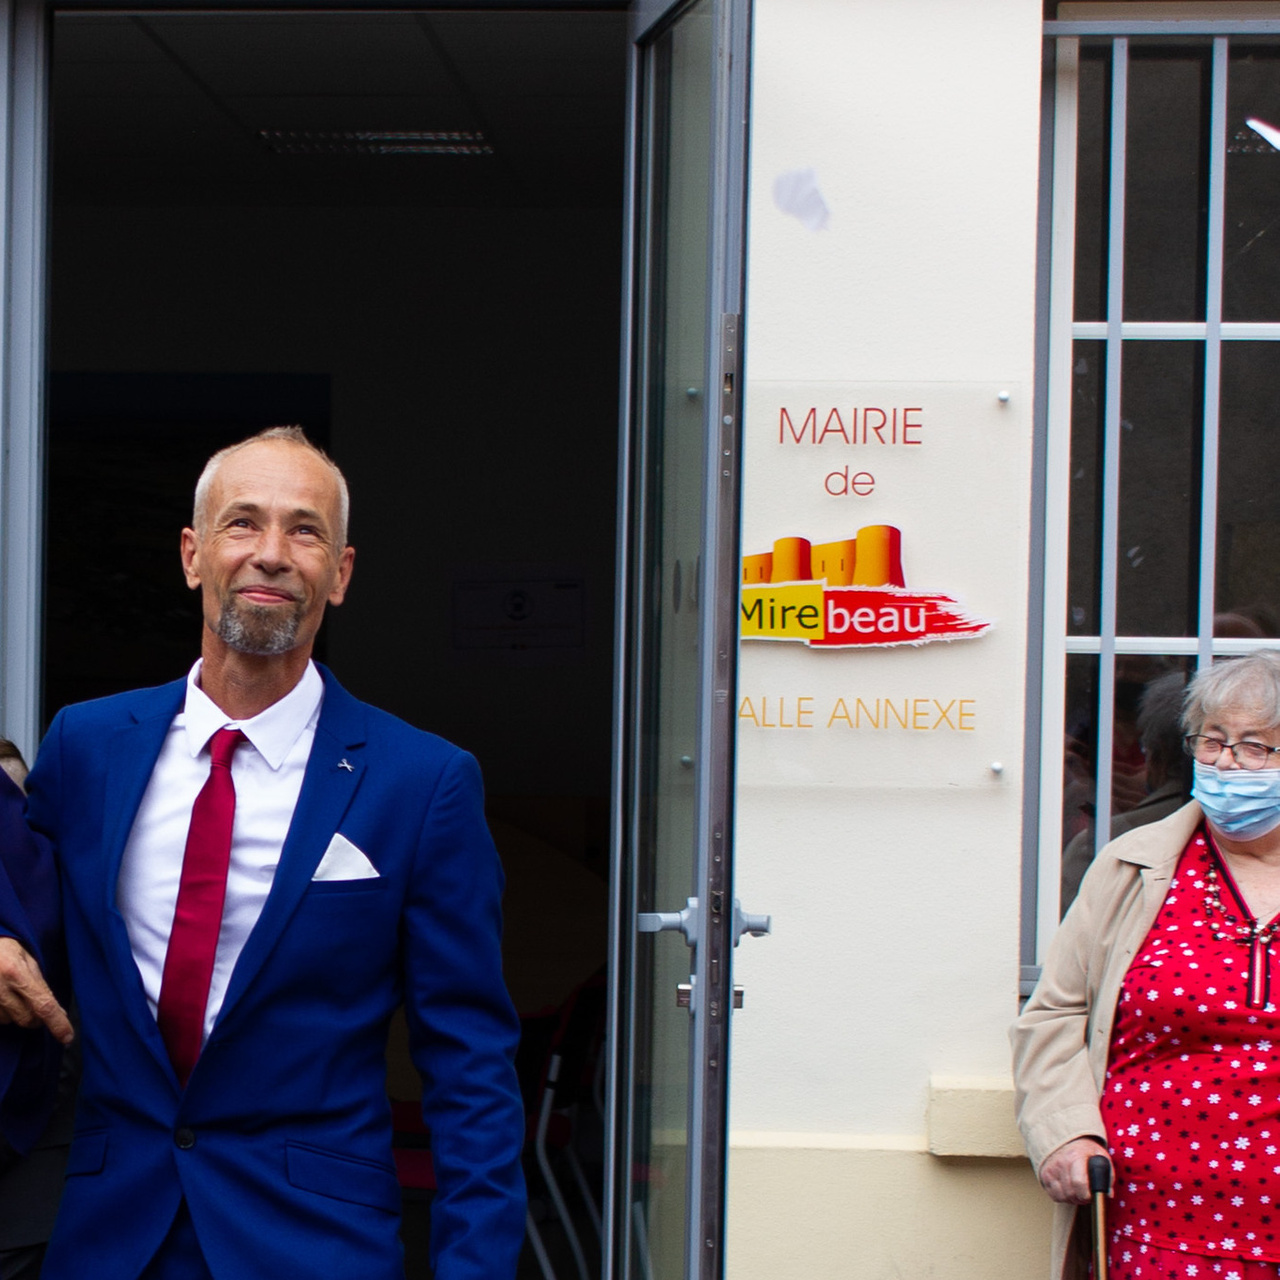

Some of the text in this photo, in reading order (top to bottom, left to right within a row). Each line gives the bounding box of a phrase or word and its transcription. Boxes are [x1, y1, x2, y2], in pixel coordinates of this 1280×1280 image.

[778, 407, 924, 445] MAIRIE
[824, 465, 876, 496] de
[738, 696, 977, 731] ALLE ANNEXE
